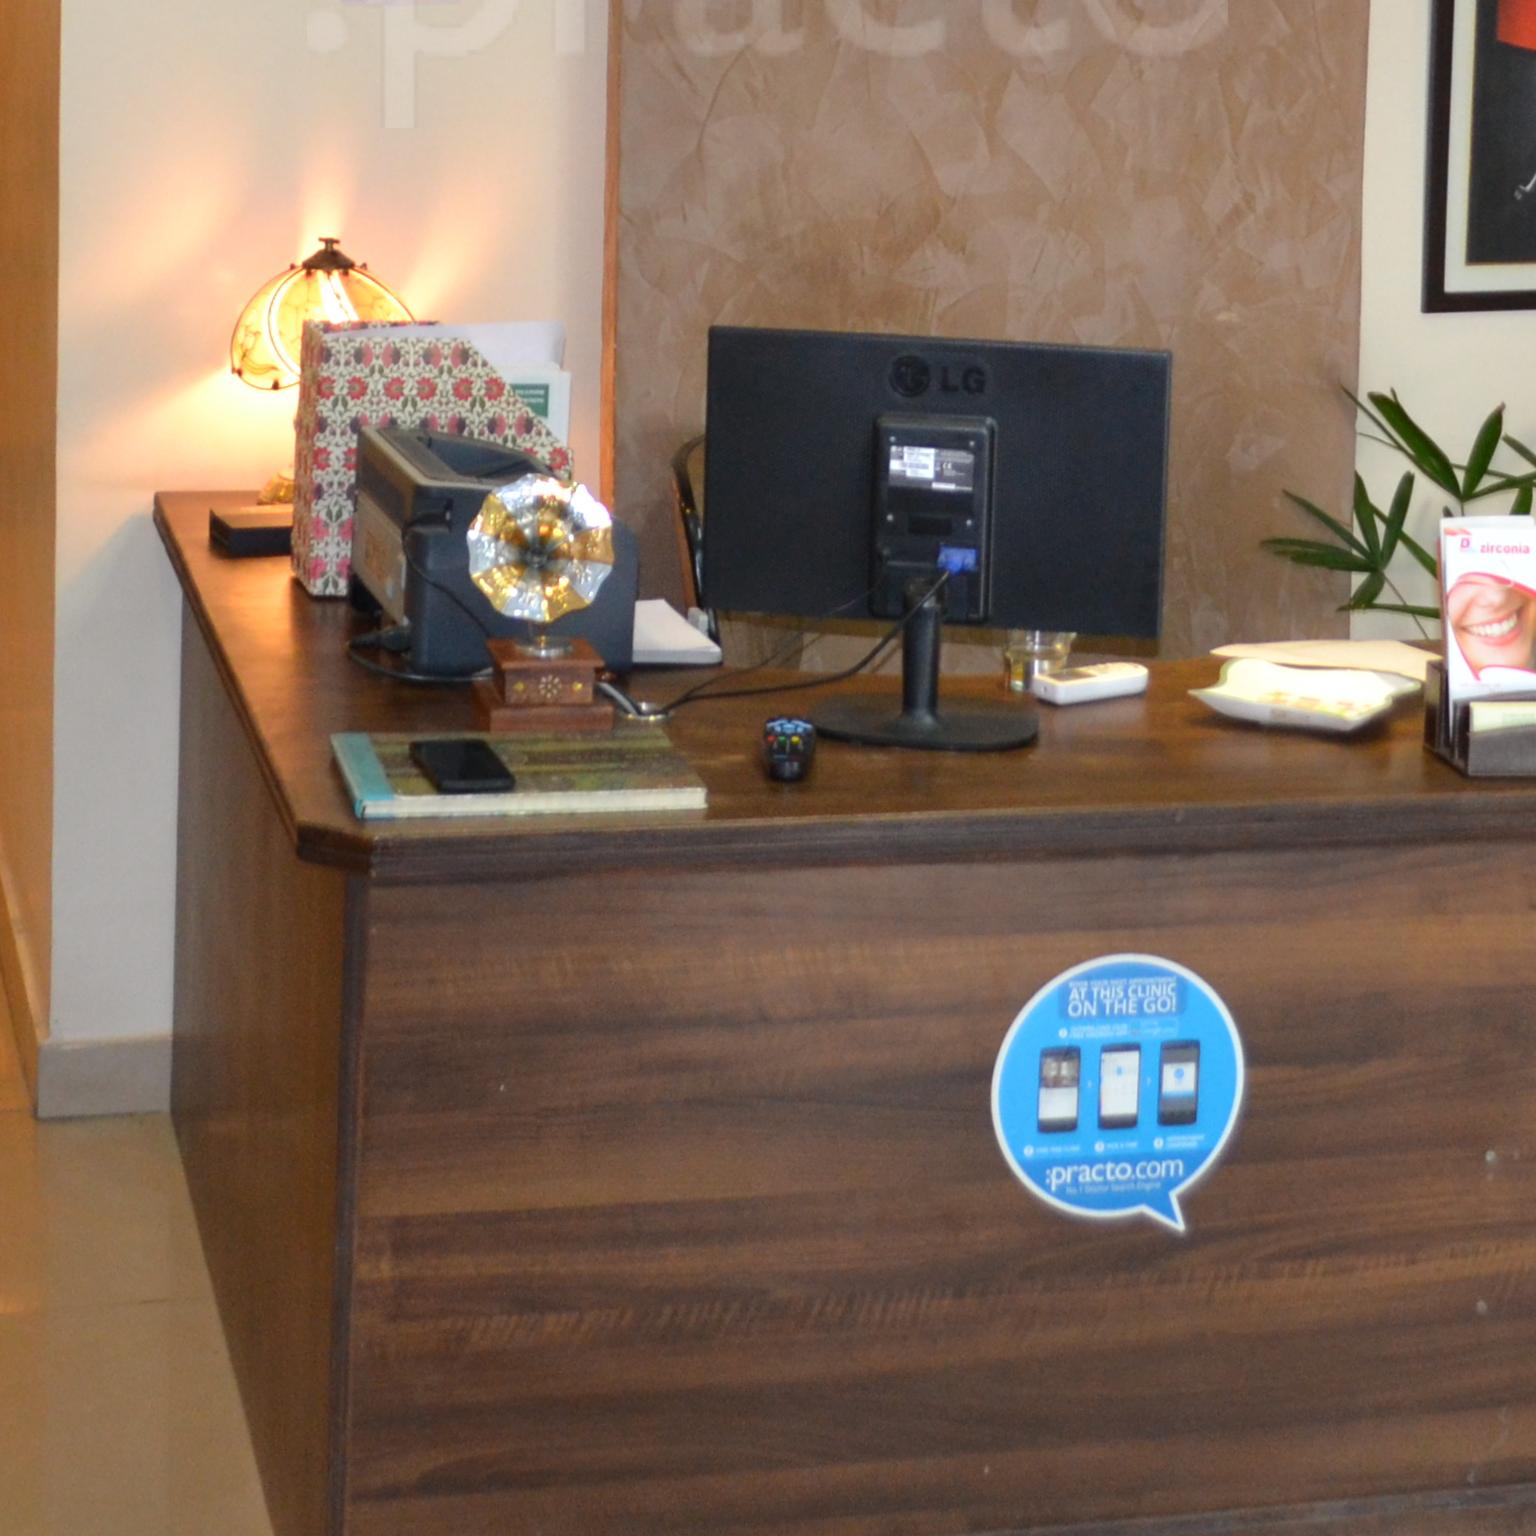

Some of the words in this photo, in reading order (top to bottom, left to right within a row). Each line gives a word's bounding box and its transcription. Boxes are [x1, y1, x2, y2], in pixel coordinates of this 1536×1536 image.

[940, 365, 987, 394] LG
[1480, 541, 1531, 555] zirconia
[1068, 986, 1088, 1001] AT
[1091, 985, 1125, 1000] THIS
[1127, 982, 1177, 998] CLINIC
[1067, 1000, 1097, 1018] ON
[1103, 997, 1138, 1016] THE
[1143, 995, 1177, 1014] GO!
